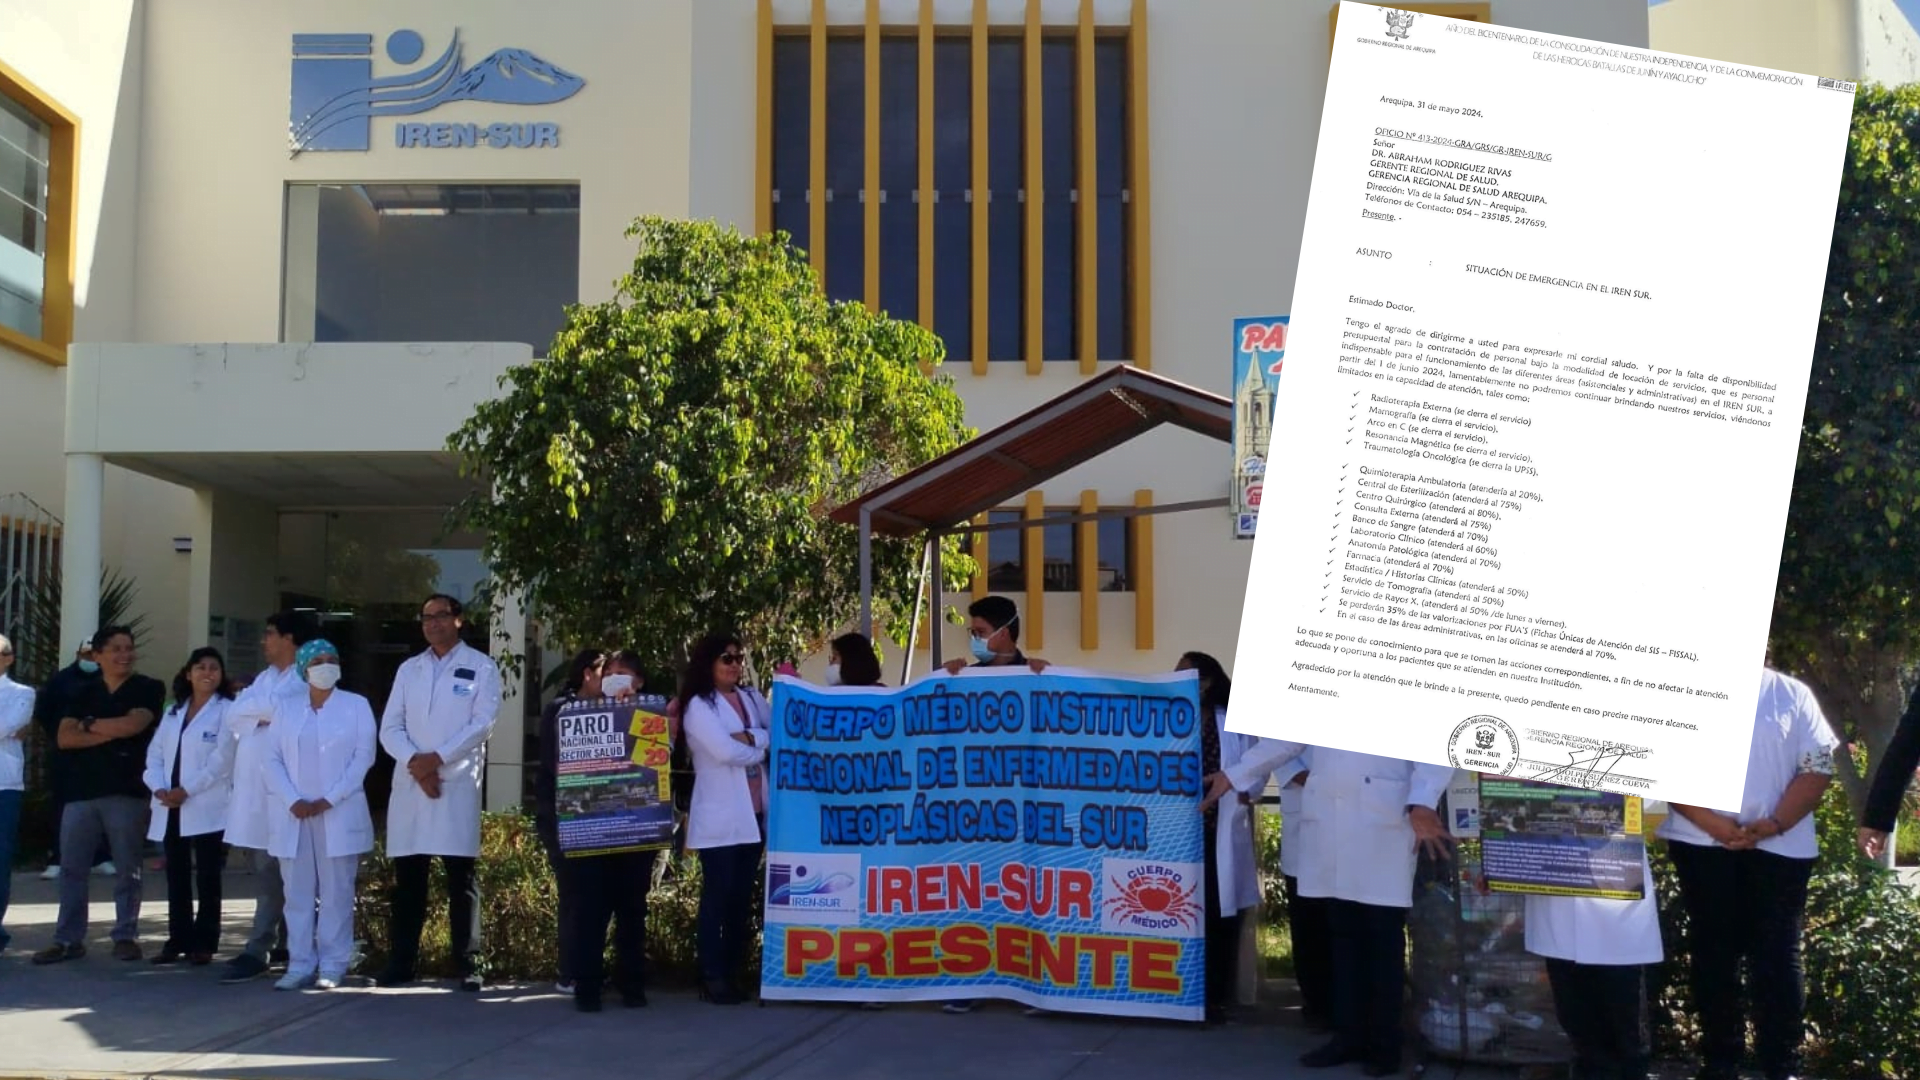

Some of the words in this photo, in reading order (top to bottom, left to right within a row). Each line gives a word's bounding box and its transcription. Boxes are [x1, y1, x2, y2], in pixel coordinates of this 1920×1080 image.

[395, 121, 560, 149] IREN-SUR
[1242, 323, 1289, 352] PA
[562, 714, 609, 737] PARO
[784, 697, 895, 742] CUERPO
[903, 684, 1023, 737] MÉDICO
[1030, 690, 1195, 740] INSTITUTO
[561, 736, 602, 748] NACIONAL
[606, 734, 623, 744] DEL
[561, 749, 592, 760] SECTOR
[594, 746, 623, 757] SALUD
[777, 748, 911, 795] REGIONAL
[918, 747, 957, 789] DE
[963, 745, 1199, 797] ENFERMEDADES
[820, 792, 1018, 845] NEOPLÁSICAS
[1024, 801, 1073, 845] DEL
[1080, 803, 1149, 851] SUR
[1127, 865, 1182, 883] CUERPO
[792, 897, 842, 908] IREN-SUR
[865, 862, 1094, 920] IREN-SUR
[1131, 914, 1178, 929] MÉDICO
[784, 923, 1183, 994] PRESENTE
